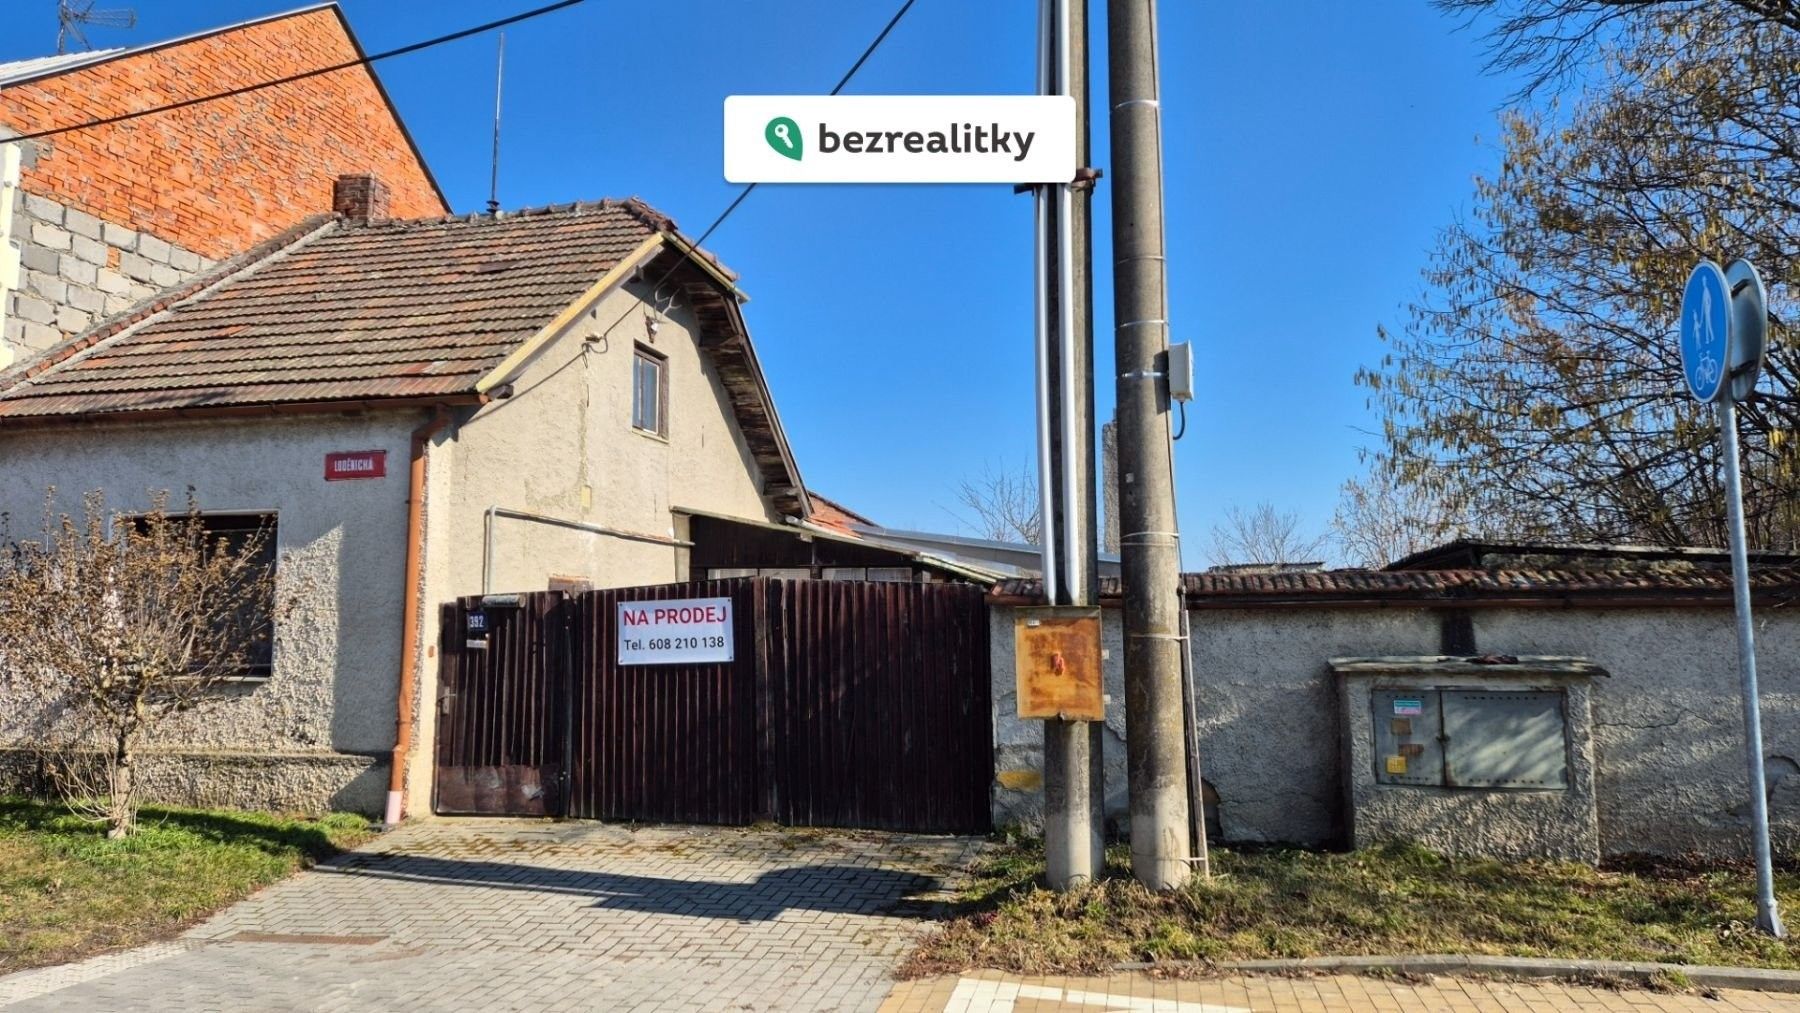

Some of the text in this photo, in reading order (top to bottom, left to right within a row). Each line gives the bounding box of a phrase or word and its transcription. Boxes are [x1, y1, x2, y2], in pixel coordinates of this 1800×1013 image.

[469, 615, 484, 628] 392
[623, 606, 727, 626] NA PRODEJ
[624, 636, 725, 651] Tel. 608 210 138
